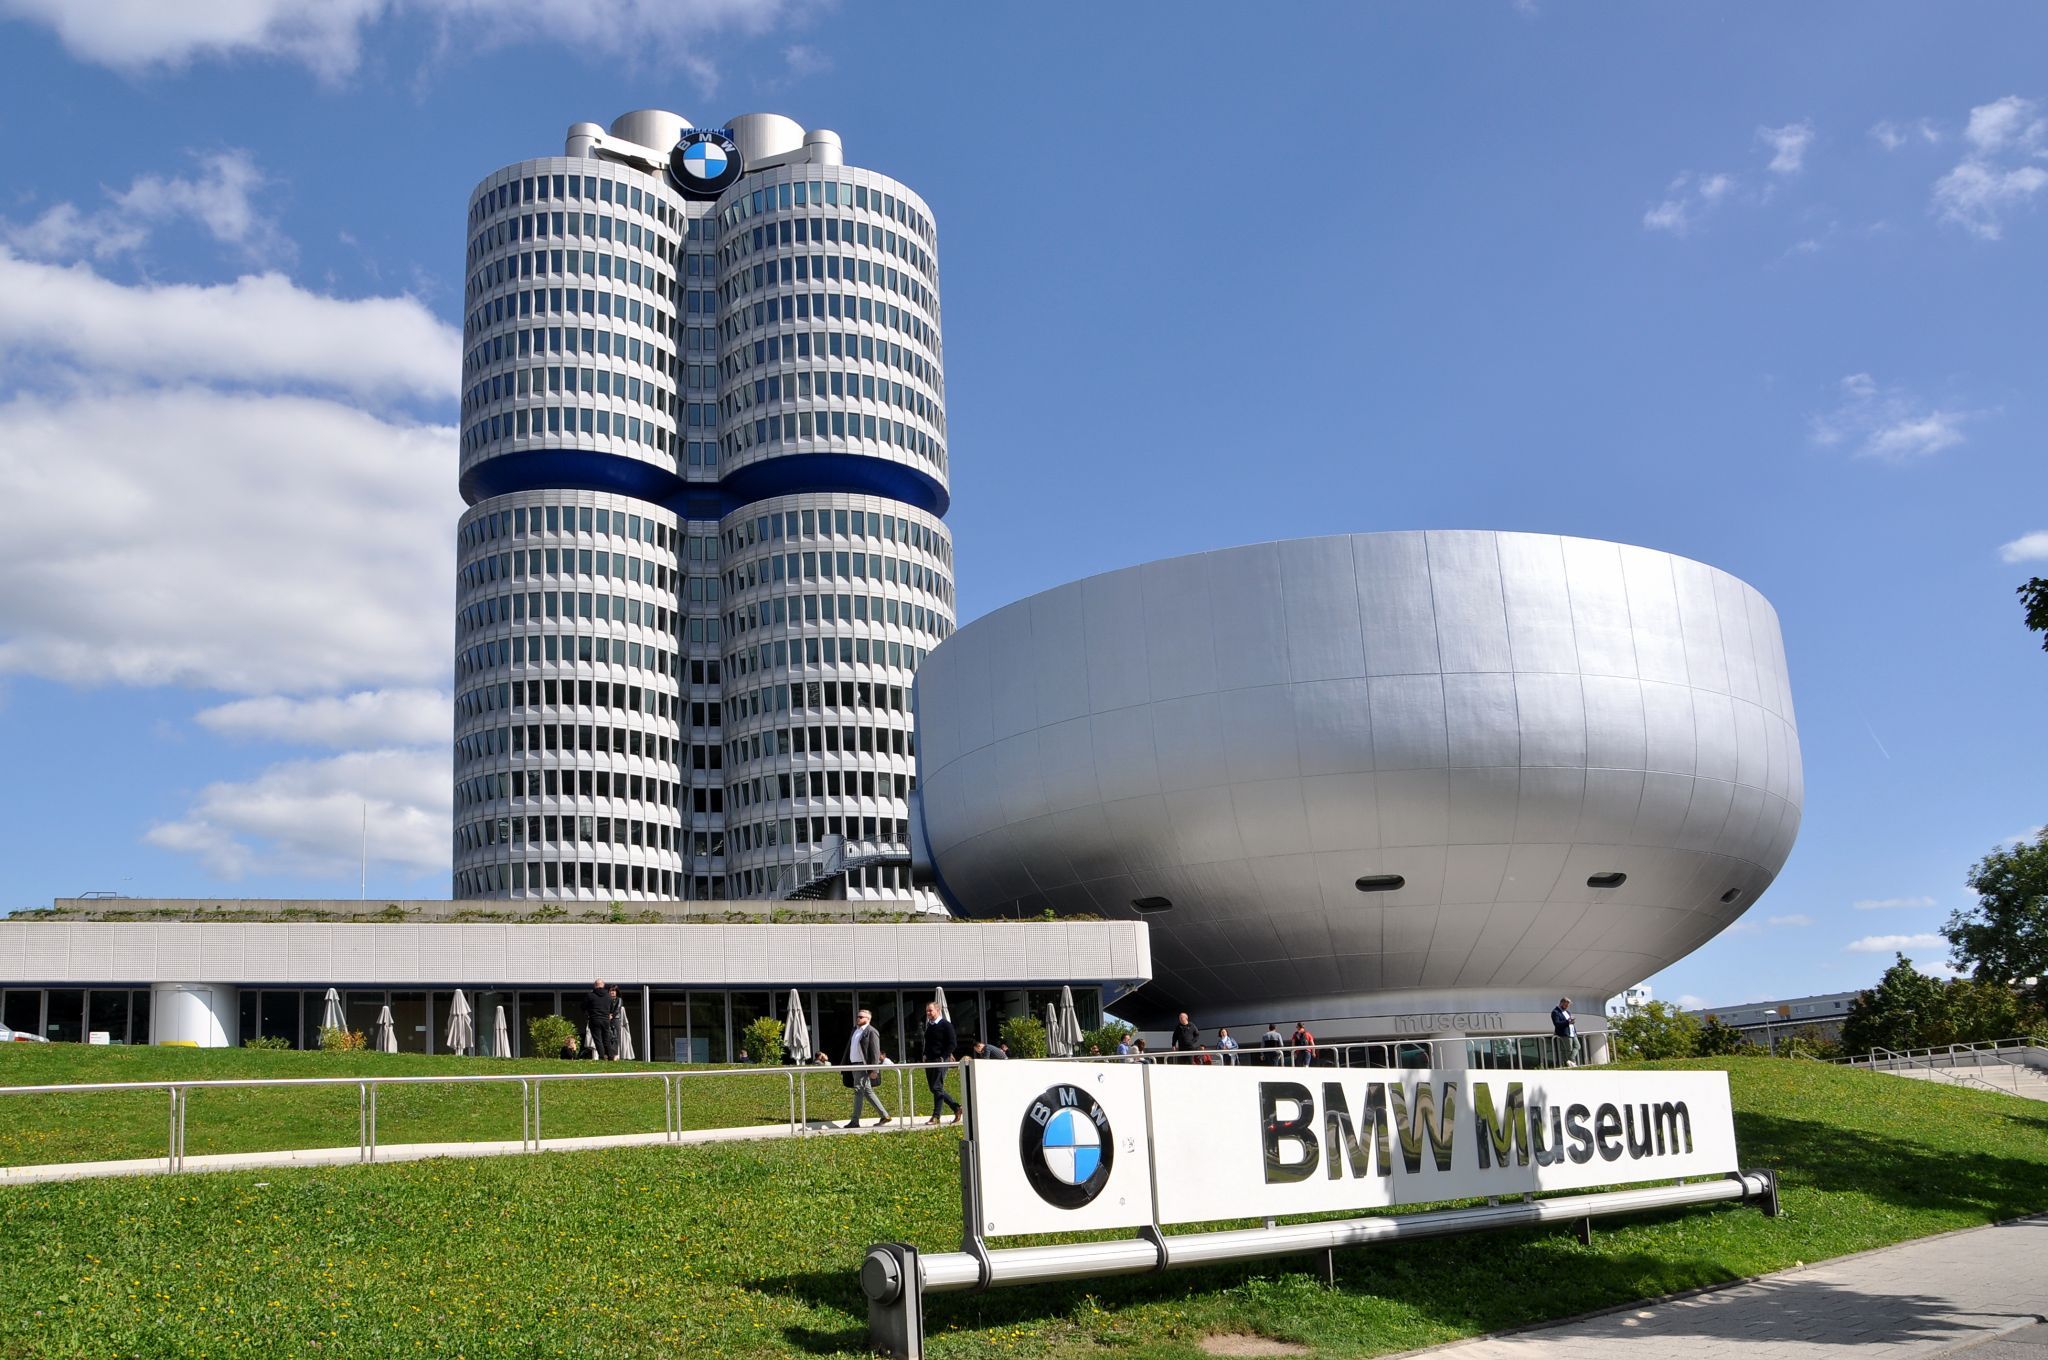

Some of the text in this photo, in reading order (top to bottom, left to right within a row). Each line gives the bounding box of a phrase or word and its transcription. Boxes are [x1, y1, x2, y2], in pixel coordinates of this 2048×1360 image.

[677, 134, 736, 152] BMW
[1394, 1013, 1504, 1033] museum
[1030, 1088, 1107, 1127] BMW
[1259, 1082, 1693, 1184] BMW Museum
